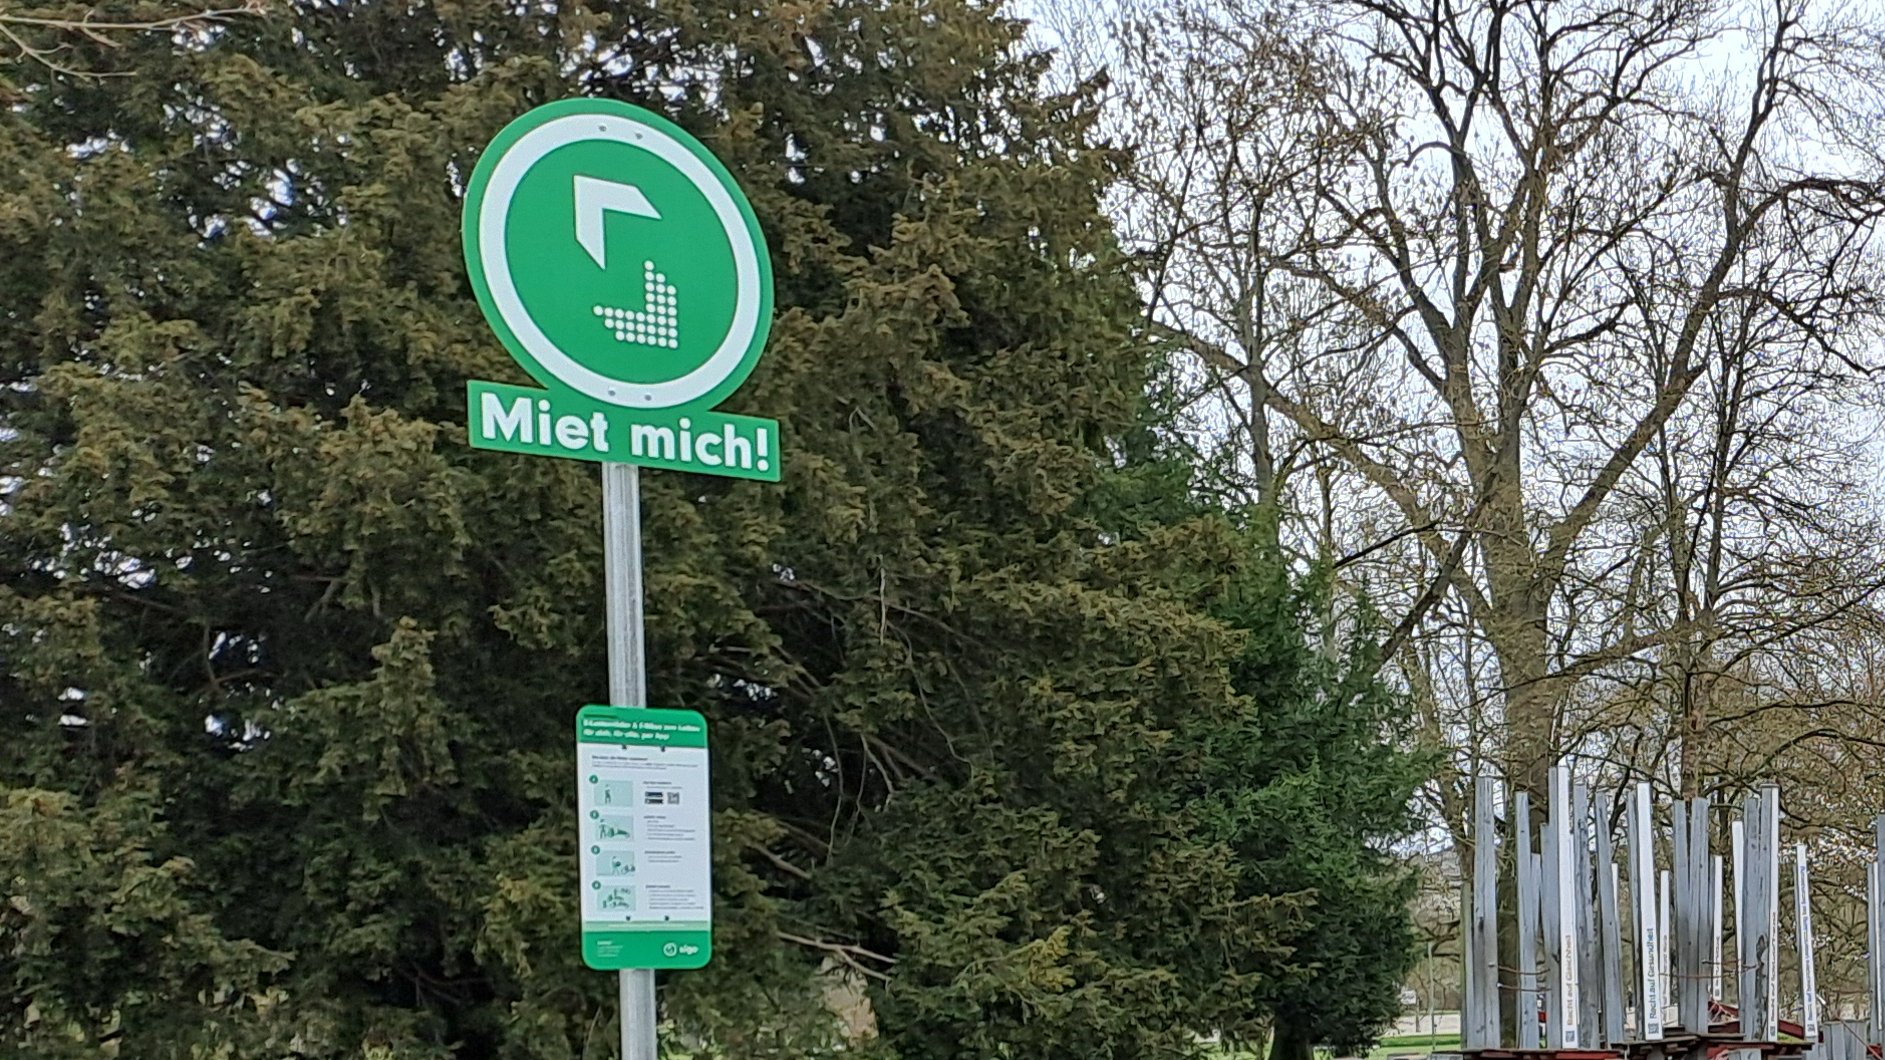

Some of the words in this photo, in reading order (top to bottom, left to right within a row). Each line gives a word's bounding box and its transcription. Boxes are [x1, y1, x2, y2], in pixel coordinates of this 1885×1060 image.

[480, 391, 609, 453] Miet
[630, 416, 770, 472] mich!
[1646, 927, 1655, 978] Gesundheit
[1647, 979, 1656, 993] auf
[1648, 994, 1657, 1020] Recht
